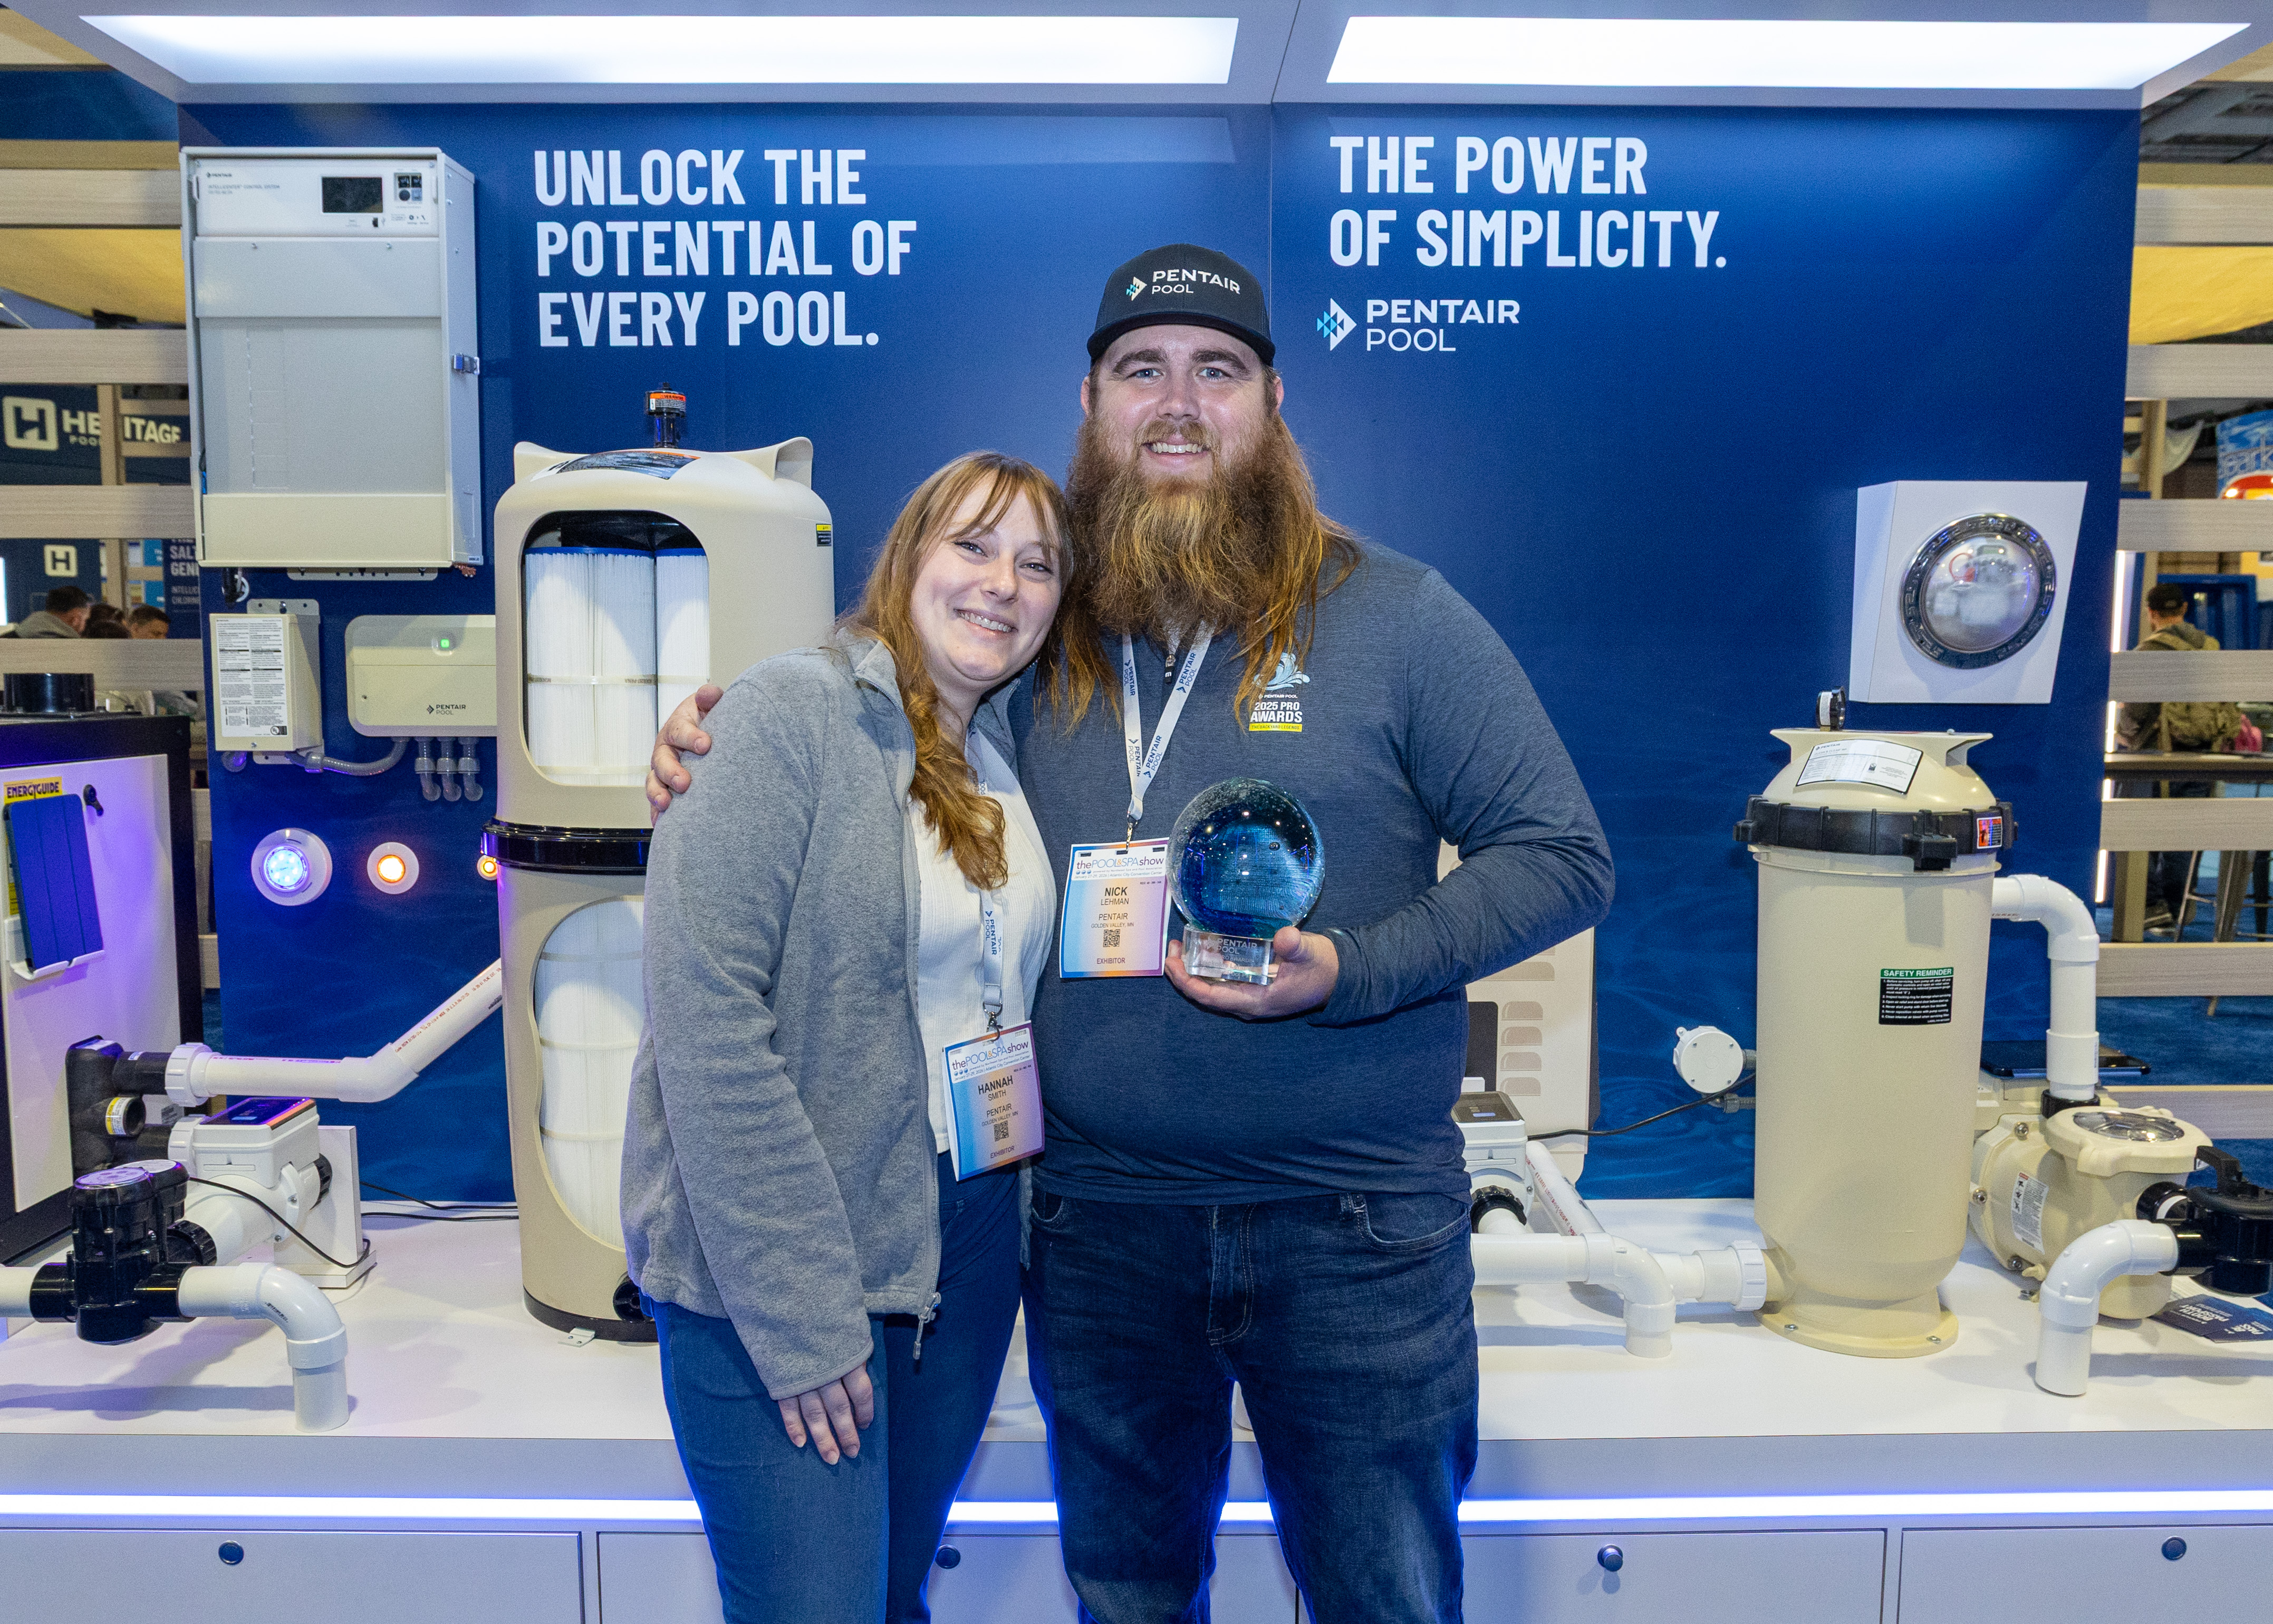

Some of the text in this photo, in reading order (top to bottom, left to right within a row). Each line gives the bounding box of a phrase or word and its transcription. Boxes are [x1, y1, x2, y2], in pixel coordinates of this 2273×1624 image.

[1330, 136, 1648, 194] THE POWER
[534, 149, 866, 206] UNLOCK THE
[1330, 209, 1727, 267] OF SIMPLICITY.
[536, 220, 917, 276] POTENTIAL OF
[1152, 269, 1240, 294] PENTAIR
[1152, 284, 1195, 294] POOL
[538, 291, 879, 347] EVERY POOL.
[1367, 300, 1520, 323] PENTAIR
[1366, 329, 1456, 351] POOL
[169, 545, 196, 560] SAL
[1179, 652, 1196, 684] PENTAIR
[1185, 668, 1197, 687] POOL
[1254, 702, 1300, 711] 2025 PRO
[1250, 710, 1303, 723] AWARDS
[1146, 735, 1162, 768] PENTAIR
[1151, 752, 1162, 771] POOL
[7, 782, 60, 799] ENERGYGUIDE
[1104, 887, 1128, 896] NICK
[1217, 938, 1258, 948] PENTAIR
[1217, 945, 1240, 955] POOL
[978, 1075, 1013, 1094] HANNAH
[988, 1089, 1006, 1101] SMITH
[987, 1103, 1012, 1118] PENTAIR
[981, 1118, 997, 1126] GOLDEN
[990, 1146, 1015, 1158] EXHIBITOR
